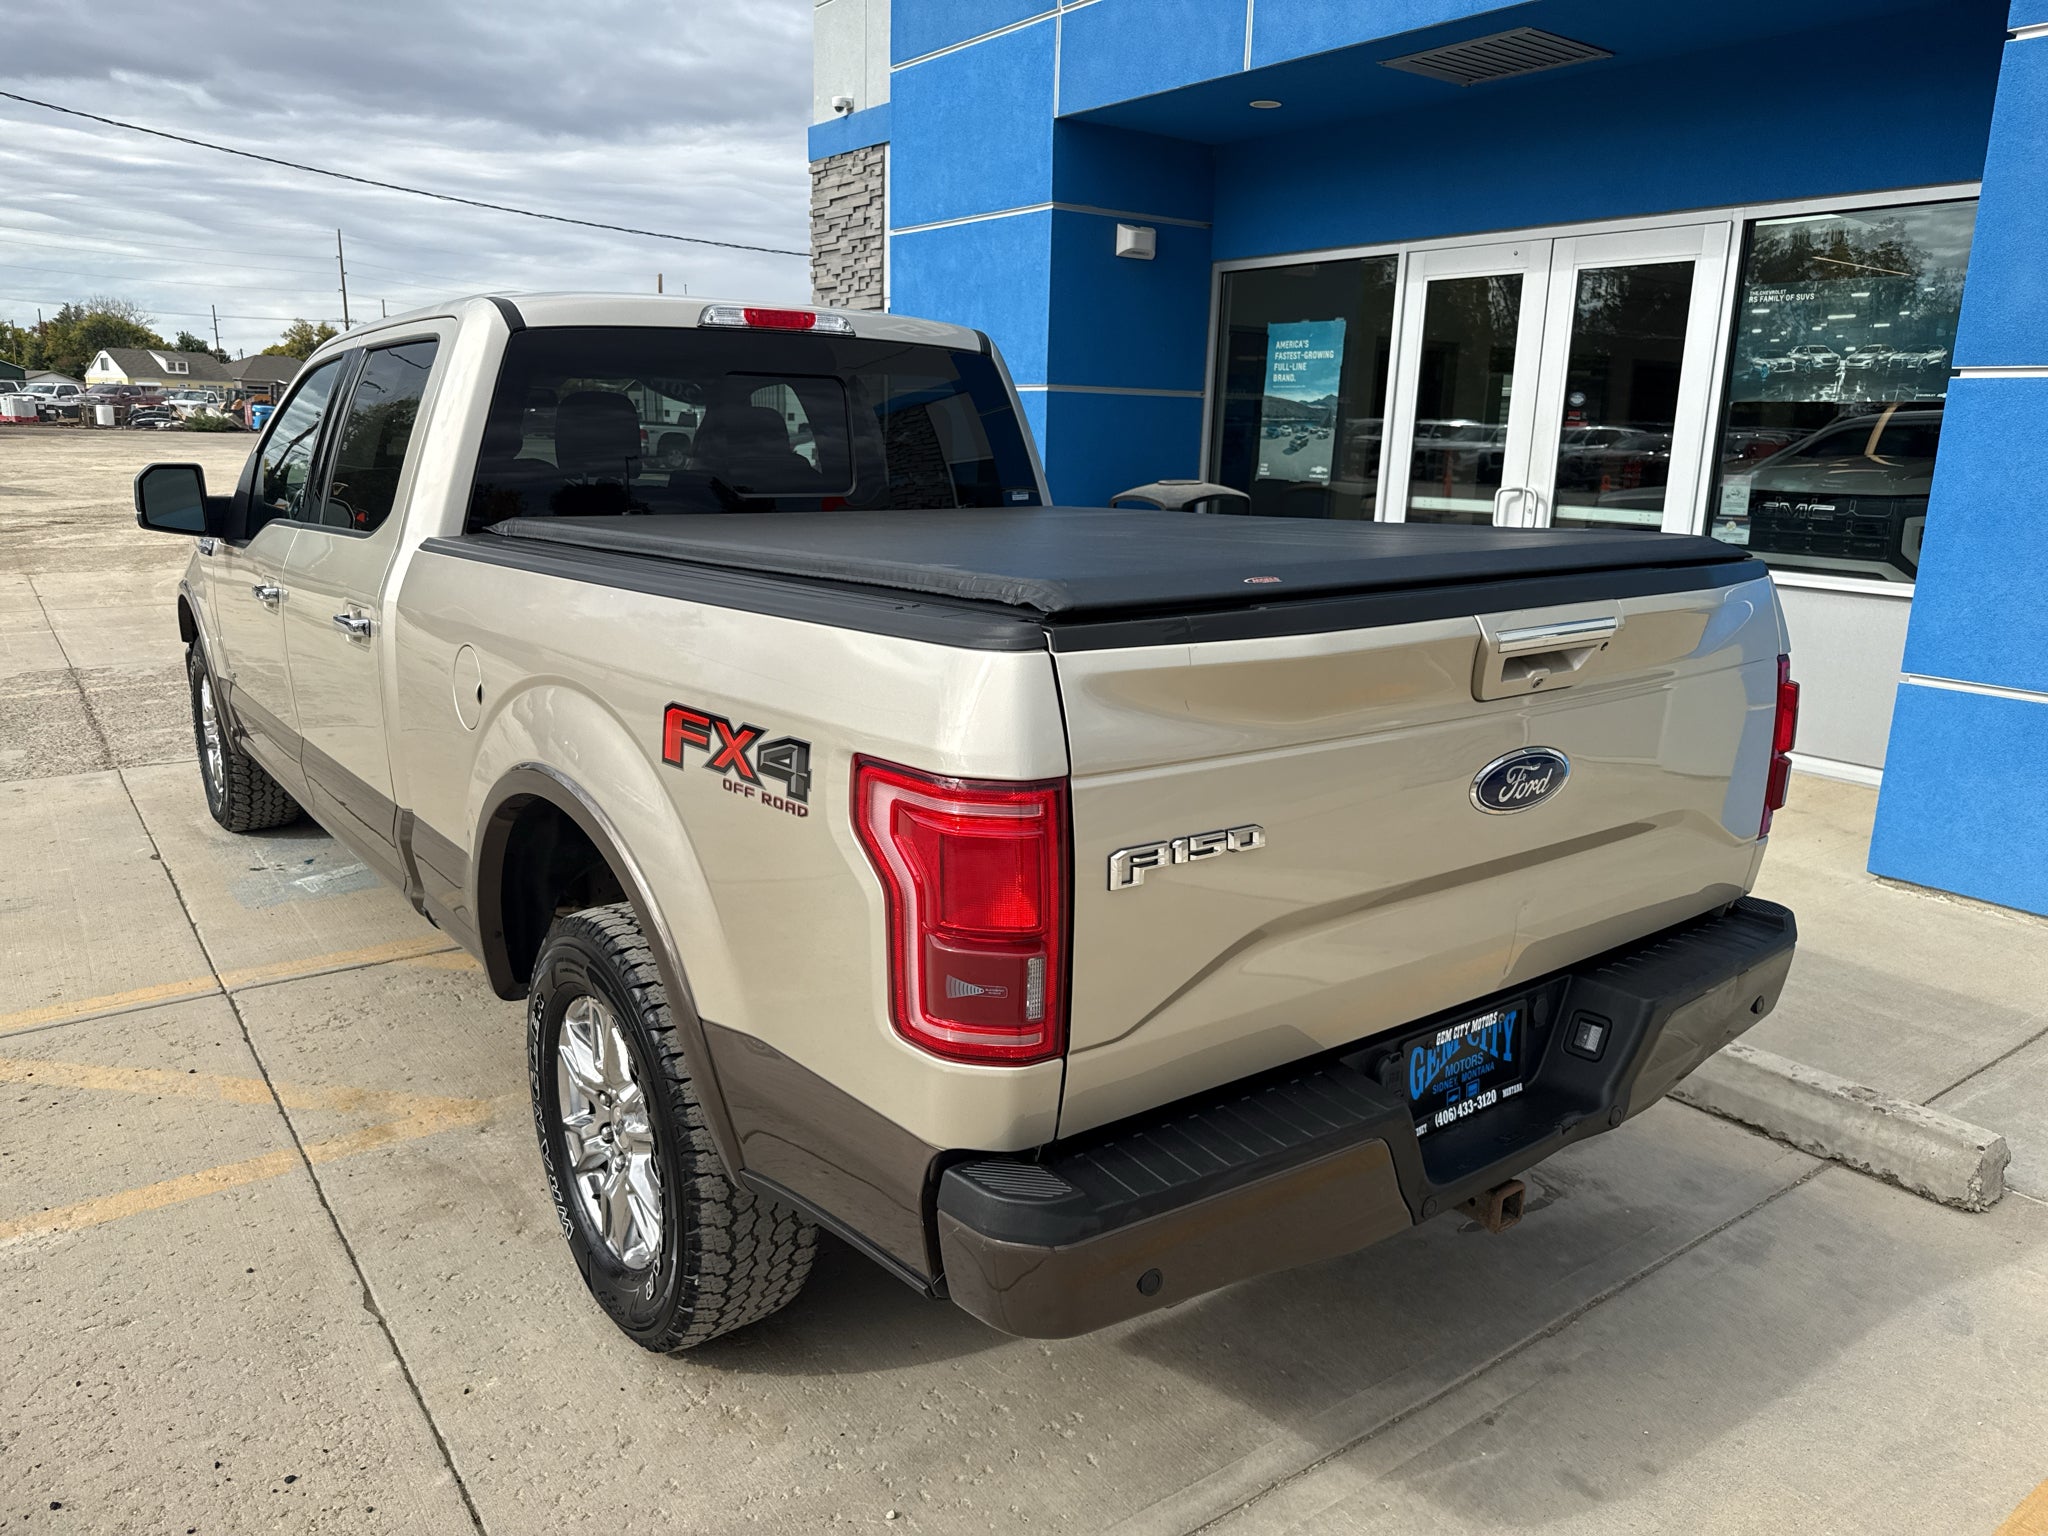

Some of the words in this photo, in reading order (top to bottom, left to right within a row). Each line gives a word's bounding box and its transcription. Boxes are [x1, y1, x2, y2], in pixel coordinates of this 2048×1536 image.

[1748, 295, 1758, 303] RS
[1759, 294, 1785, 303] FAMILY
[1785, 293, 1795, 302] OF
[1796, 292, 1815, 301] SUVS
[1274, 350, 1335, 360] FASTEST-GROWING
[1275, 339, 1310, 350] AMERICA'S
[1272, 373, 1297, 382] BRAND.
[1273, 362, 1307, 371] FULL-LINE
[661, 700, 812, 805] FX4
[722, 777, 756, 798] OFF
[761, 790, 809, 818] ROAD
[1498, 762, 1553, 803] Ford
[1436, 1027, 1455, 1046] GEM
[1453, 1021, 1471, 1040] CITY
[1471, 1011, 1499, 1033] MOTORS
[1409, 1037, 1461, 1100] GEM
[1444, 1051, 1484, 1078] MOTORS
[1461, 1061, 1495, 1083] MONTANA
[528, 991, 574, 1241] WRANGLER
[1434, 1106, 1457, 1128] (406)
[1457, 1088, 1497, 1118] 433-3120
